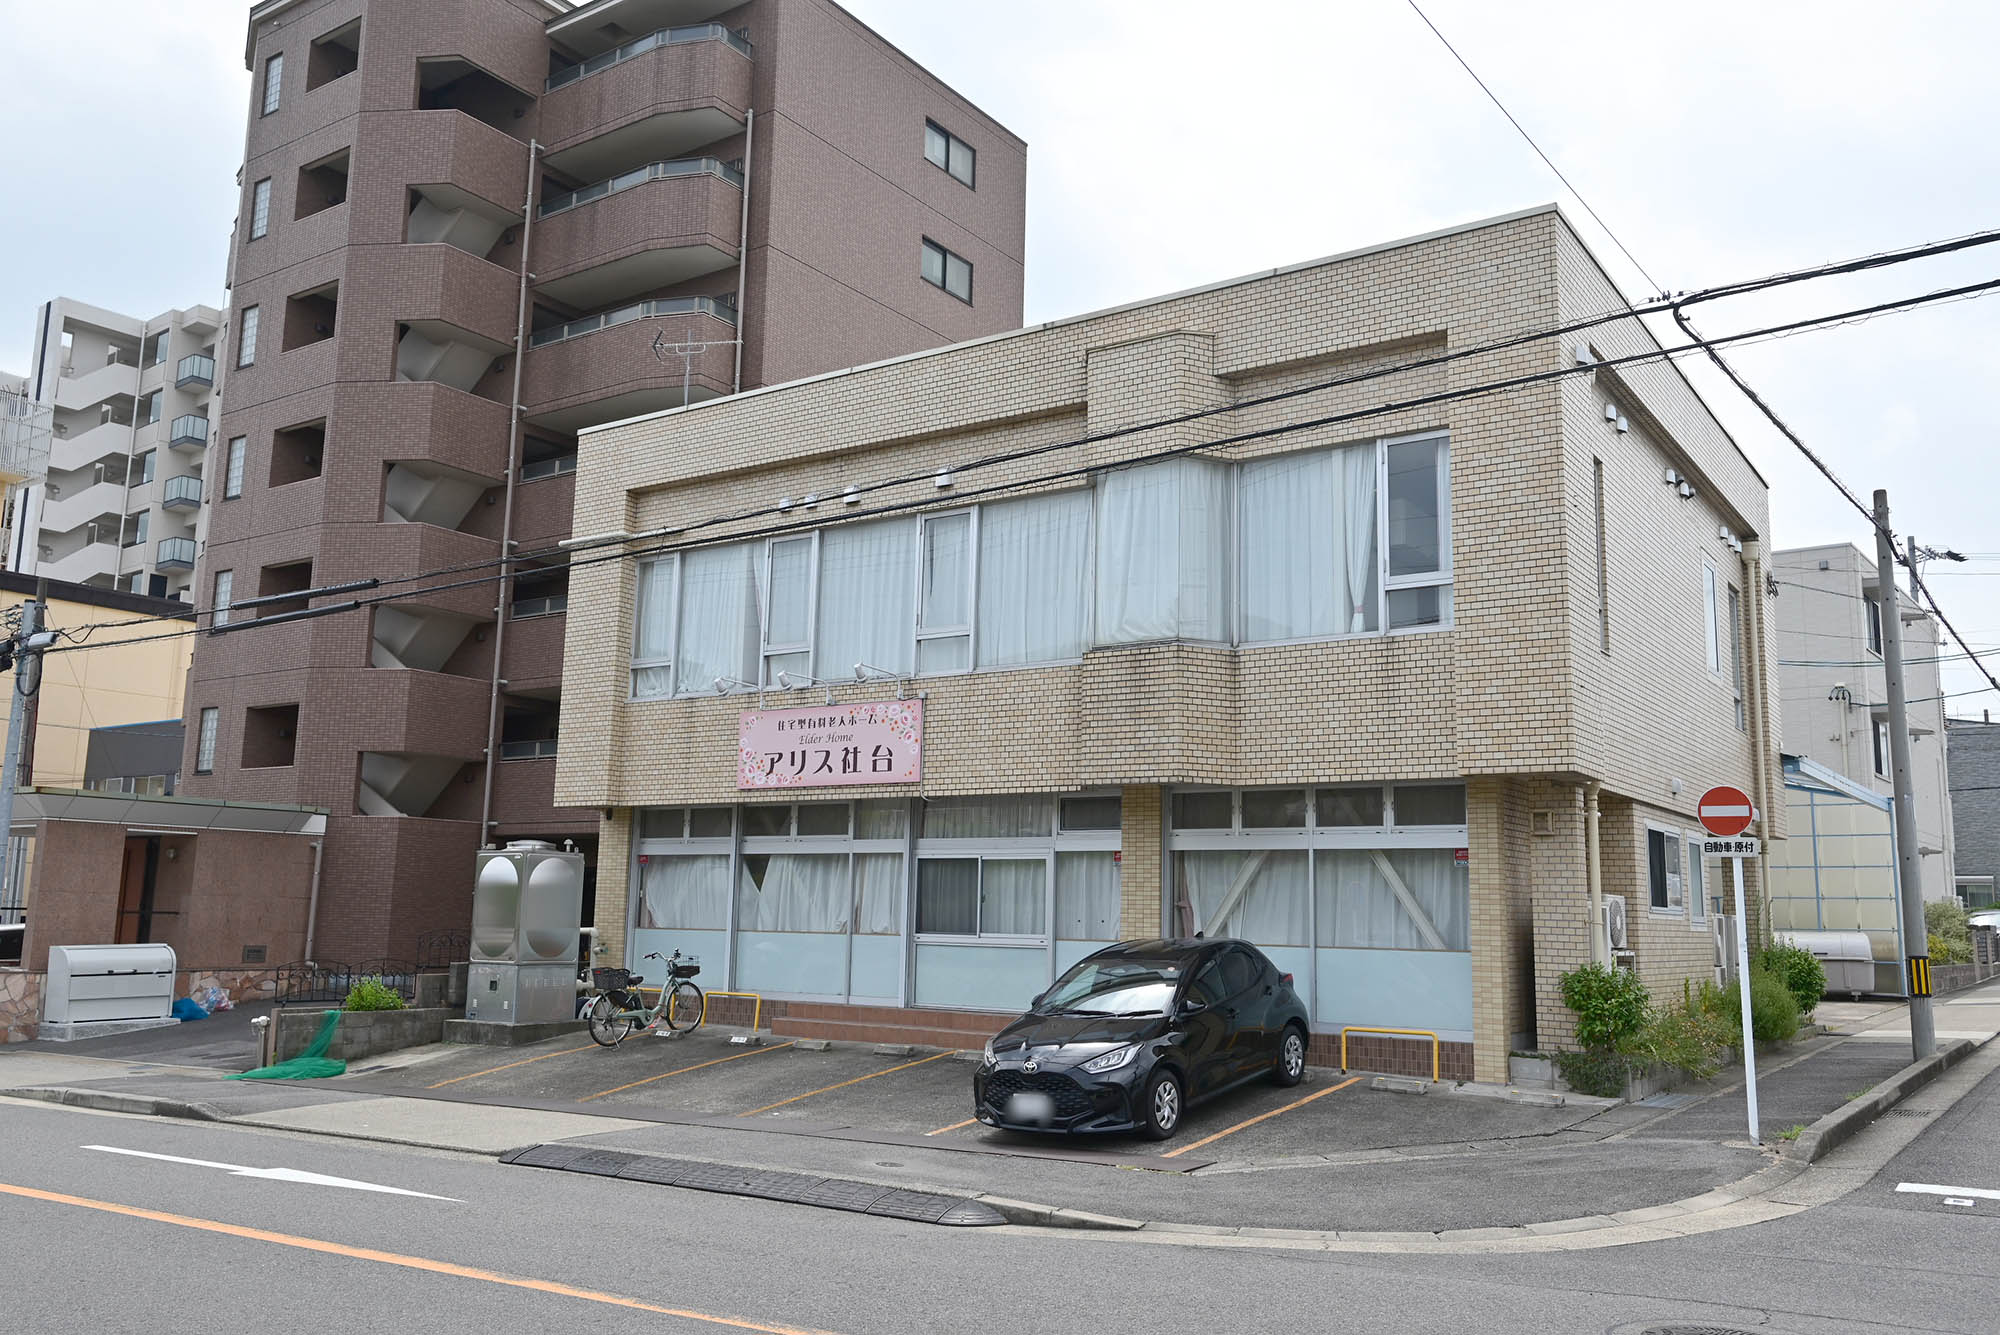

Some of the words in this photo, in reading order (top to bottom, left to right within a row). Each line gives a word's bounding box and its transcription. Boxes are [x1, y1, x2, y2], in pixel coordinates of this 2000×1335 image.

[777, 713, 878, 732] 住宅型有料老人ホーム
[798, 733, 824, 745] Elder
[825, 731, 854, 744] Home
[764, 744, 894, 777] アリス社台
